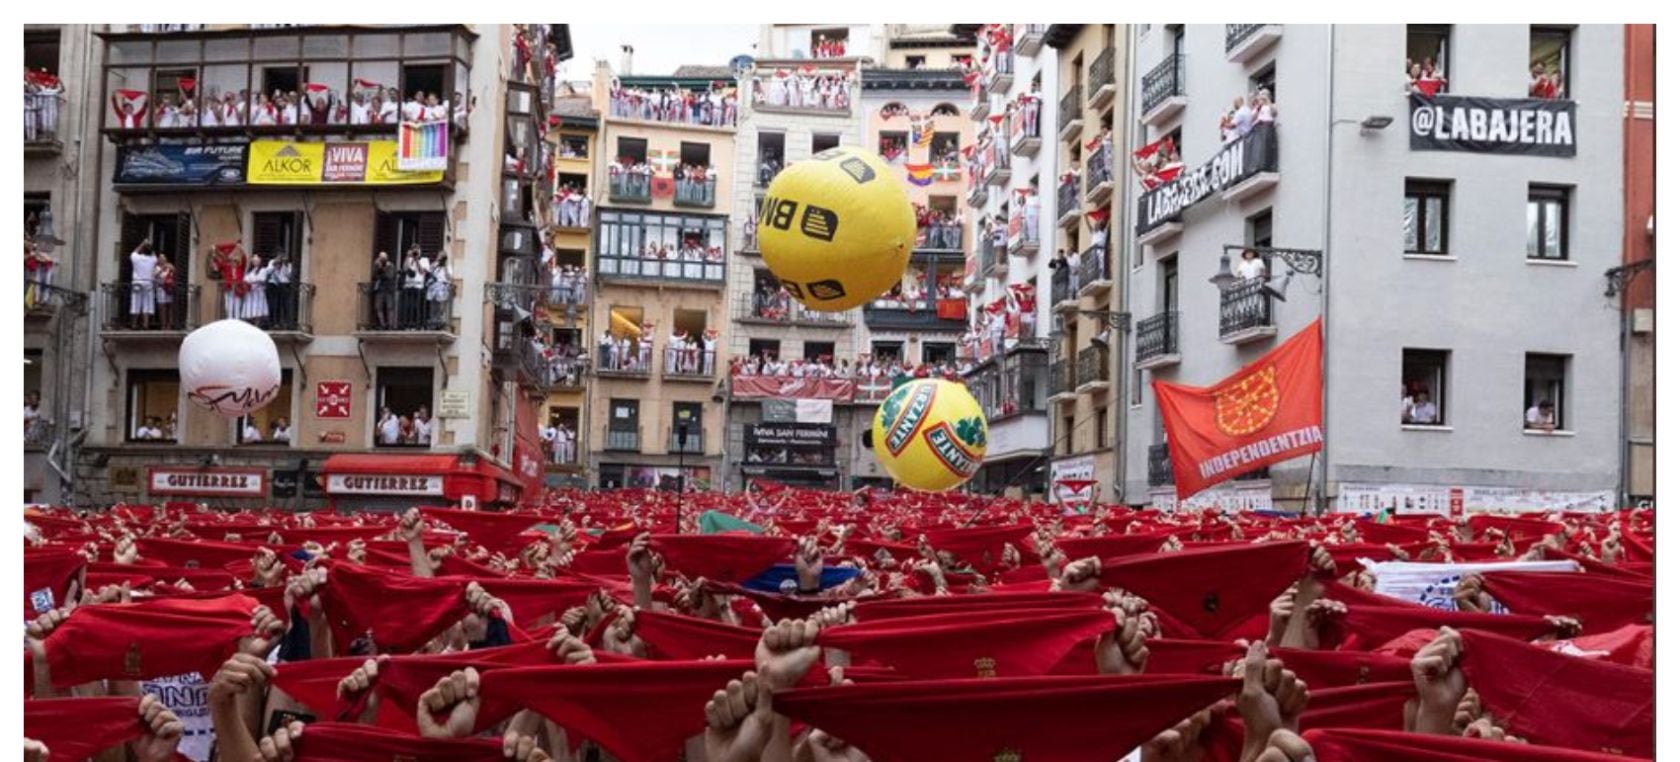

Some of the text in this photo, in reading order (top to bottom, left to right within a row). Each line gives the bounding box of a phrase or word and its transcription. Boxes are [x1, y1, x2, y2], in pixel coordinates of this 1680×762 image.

[1412, 105, 1573, 145] @LABAJERA
[263, 157, 312, 173] ALKOR
[1199, 424, 1323, 479] INDEPENDENTZIA
[168, 474, 248, 488] GUTIERREZ
[343, 476, 428, 490] GUTIERREZ
